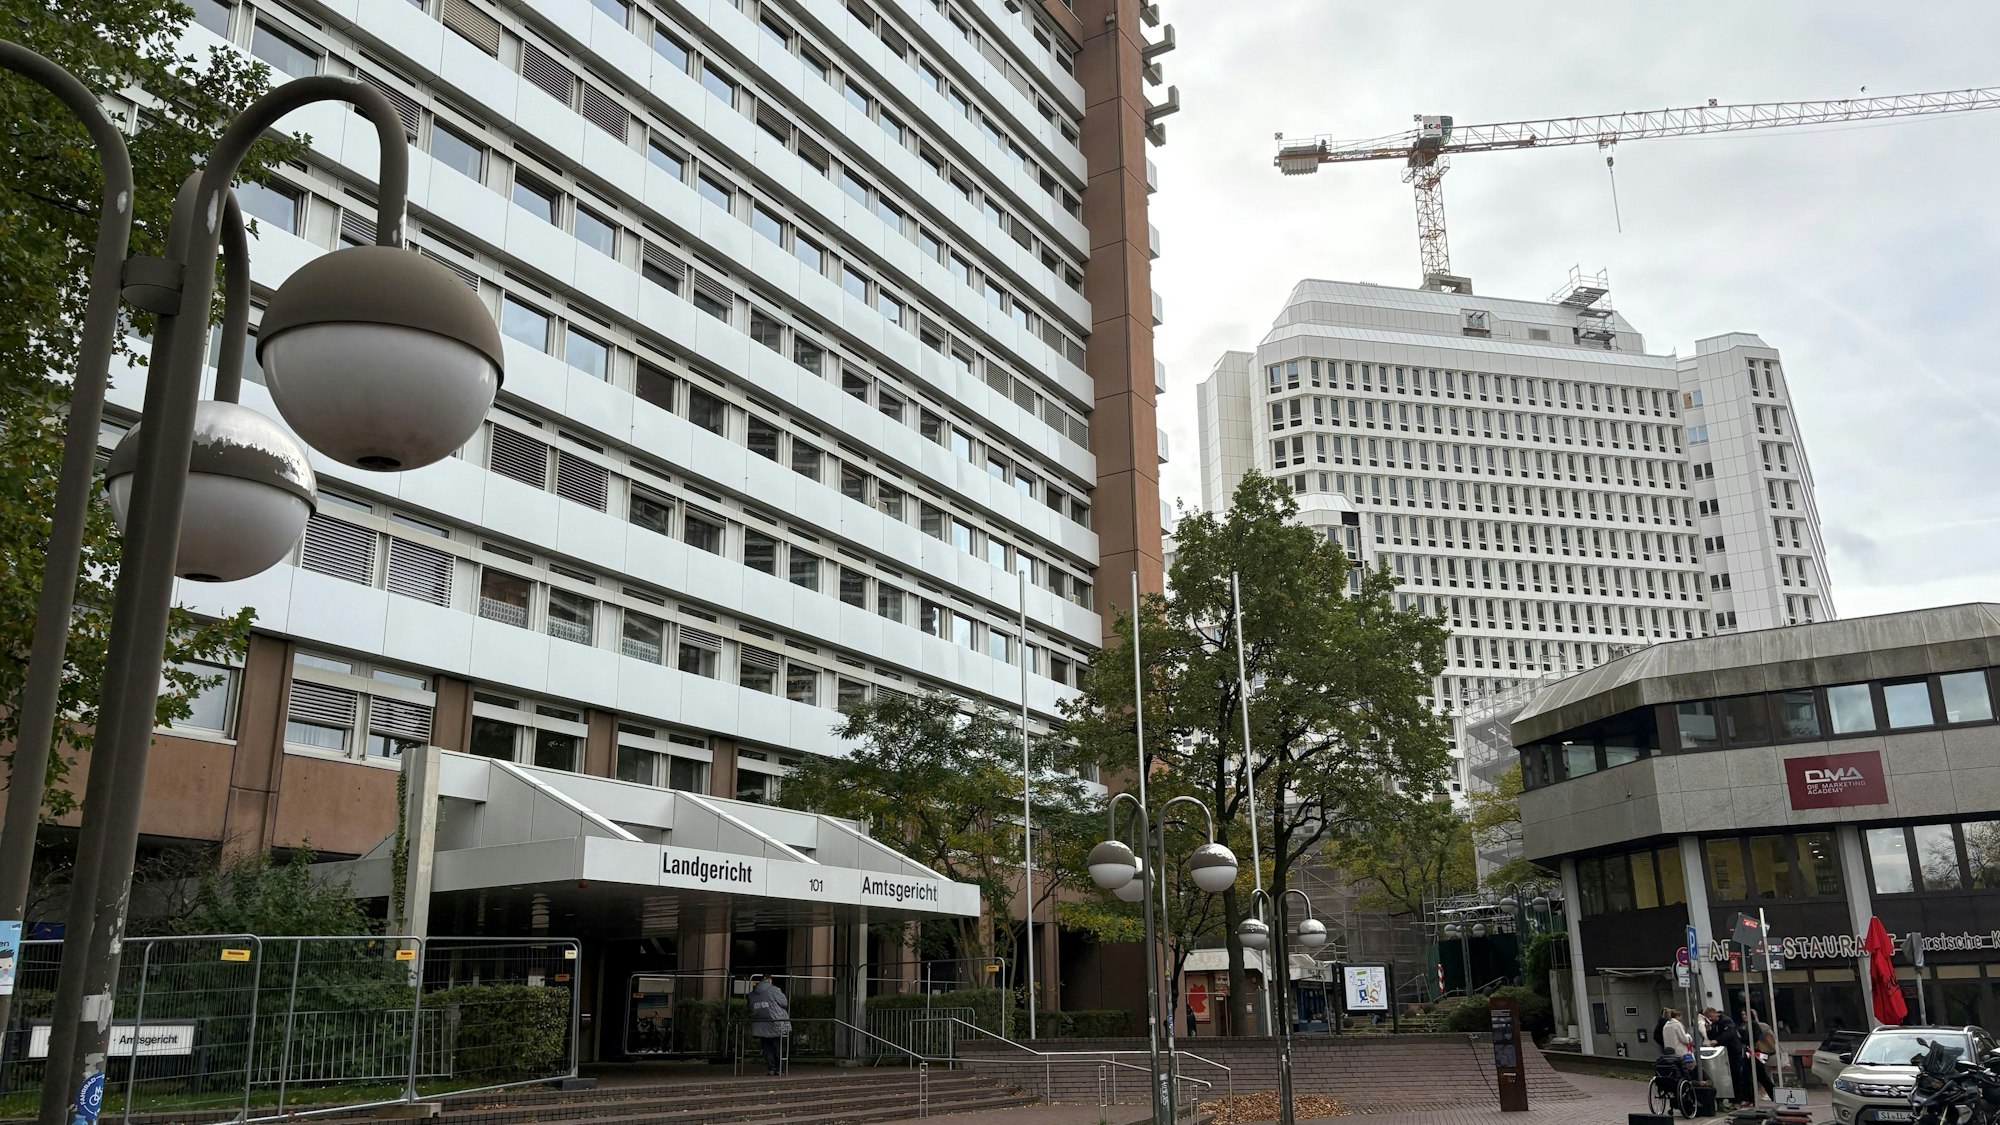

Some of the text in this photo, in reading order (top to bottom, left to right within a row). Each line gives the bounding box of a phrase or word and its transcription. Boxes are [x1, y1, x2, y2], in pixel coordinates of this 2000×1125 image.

[1804, 767, 1864, 784] DMA
[1807, 787, 1844, 795] ACADEMY
[1821, 780, 1866, 789] MARKETING
[662, 852, 938, 902] Landgericht 101 Amtsgericht
